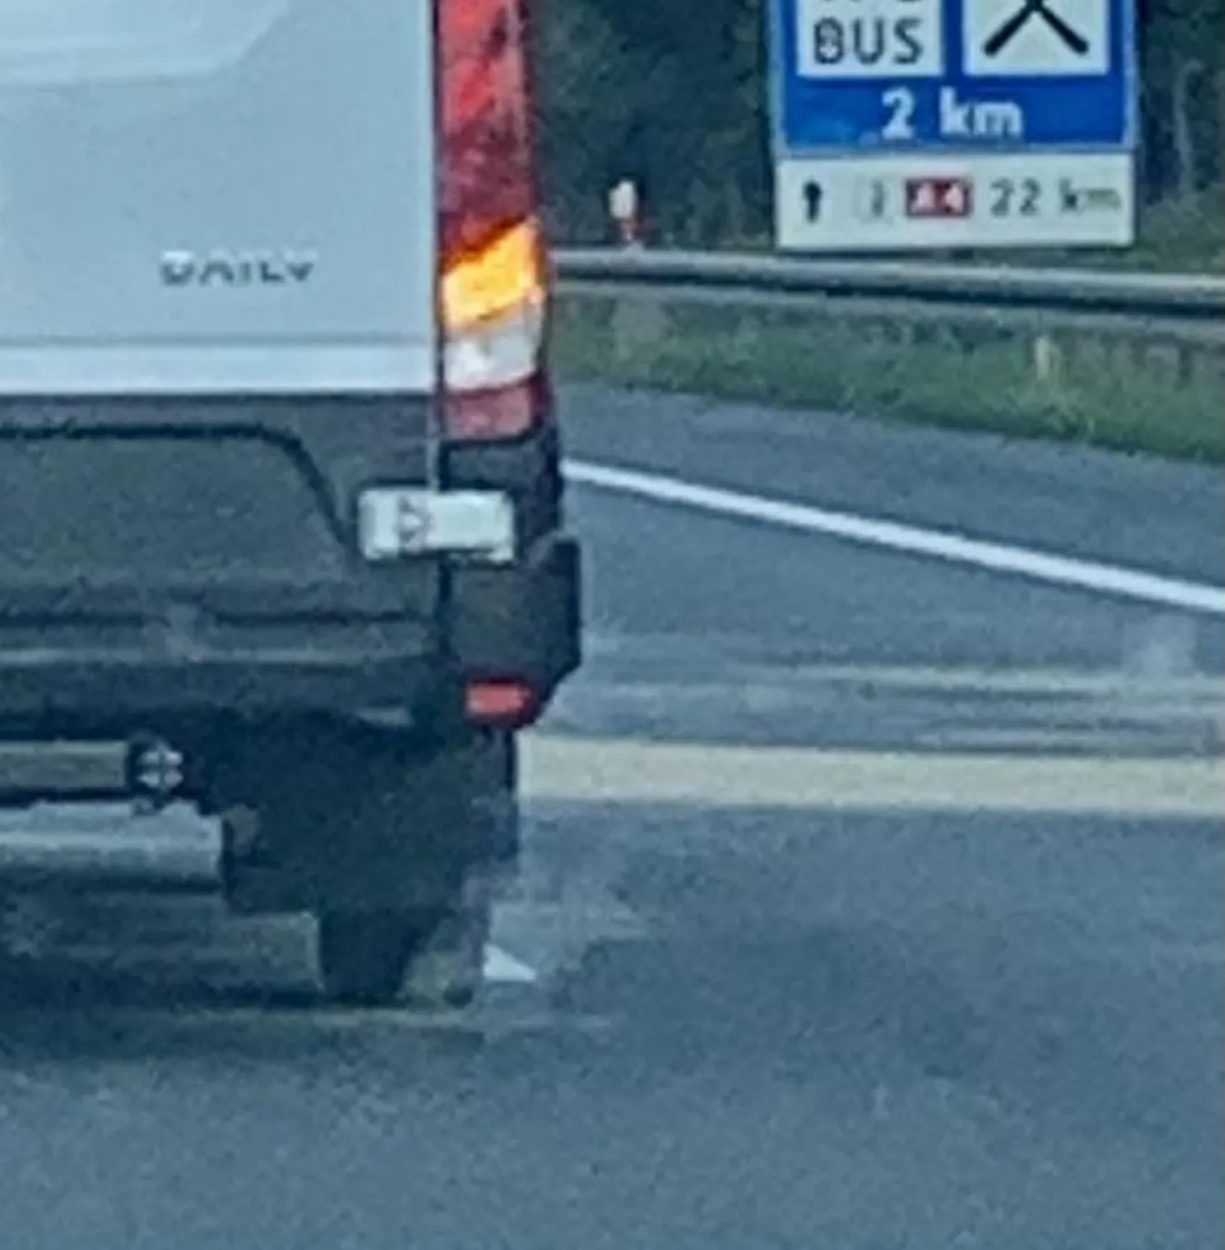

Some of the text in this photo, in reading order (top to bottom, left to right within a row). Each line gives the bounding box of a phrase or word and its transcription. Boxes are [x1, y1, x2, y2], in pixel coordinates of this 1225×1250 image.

[812, 16, 925, 65] BUS
[881, 87, 1023, 140] 2 km
[989, 179, 1042, 215] 22
[1057, 177, 1121, 211] km
[160, 250, 318, 287] DAILY
